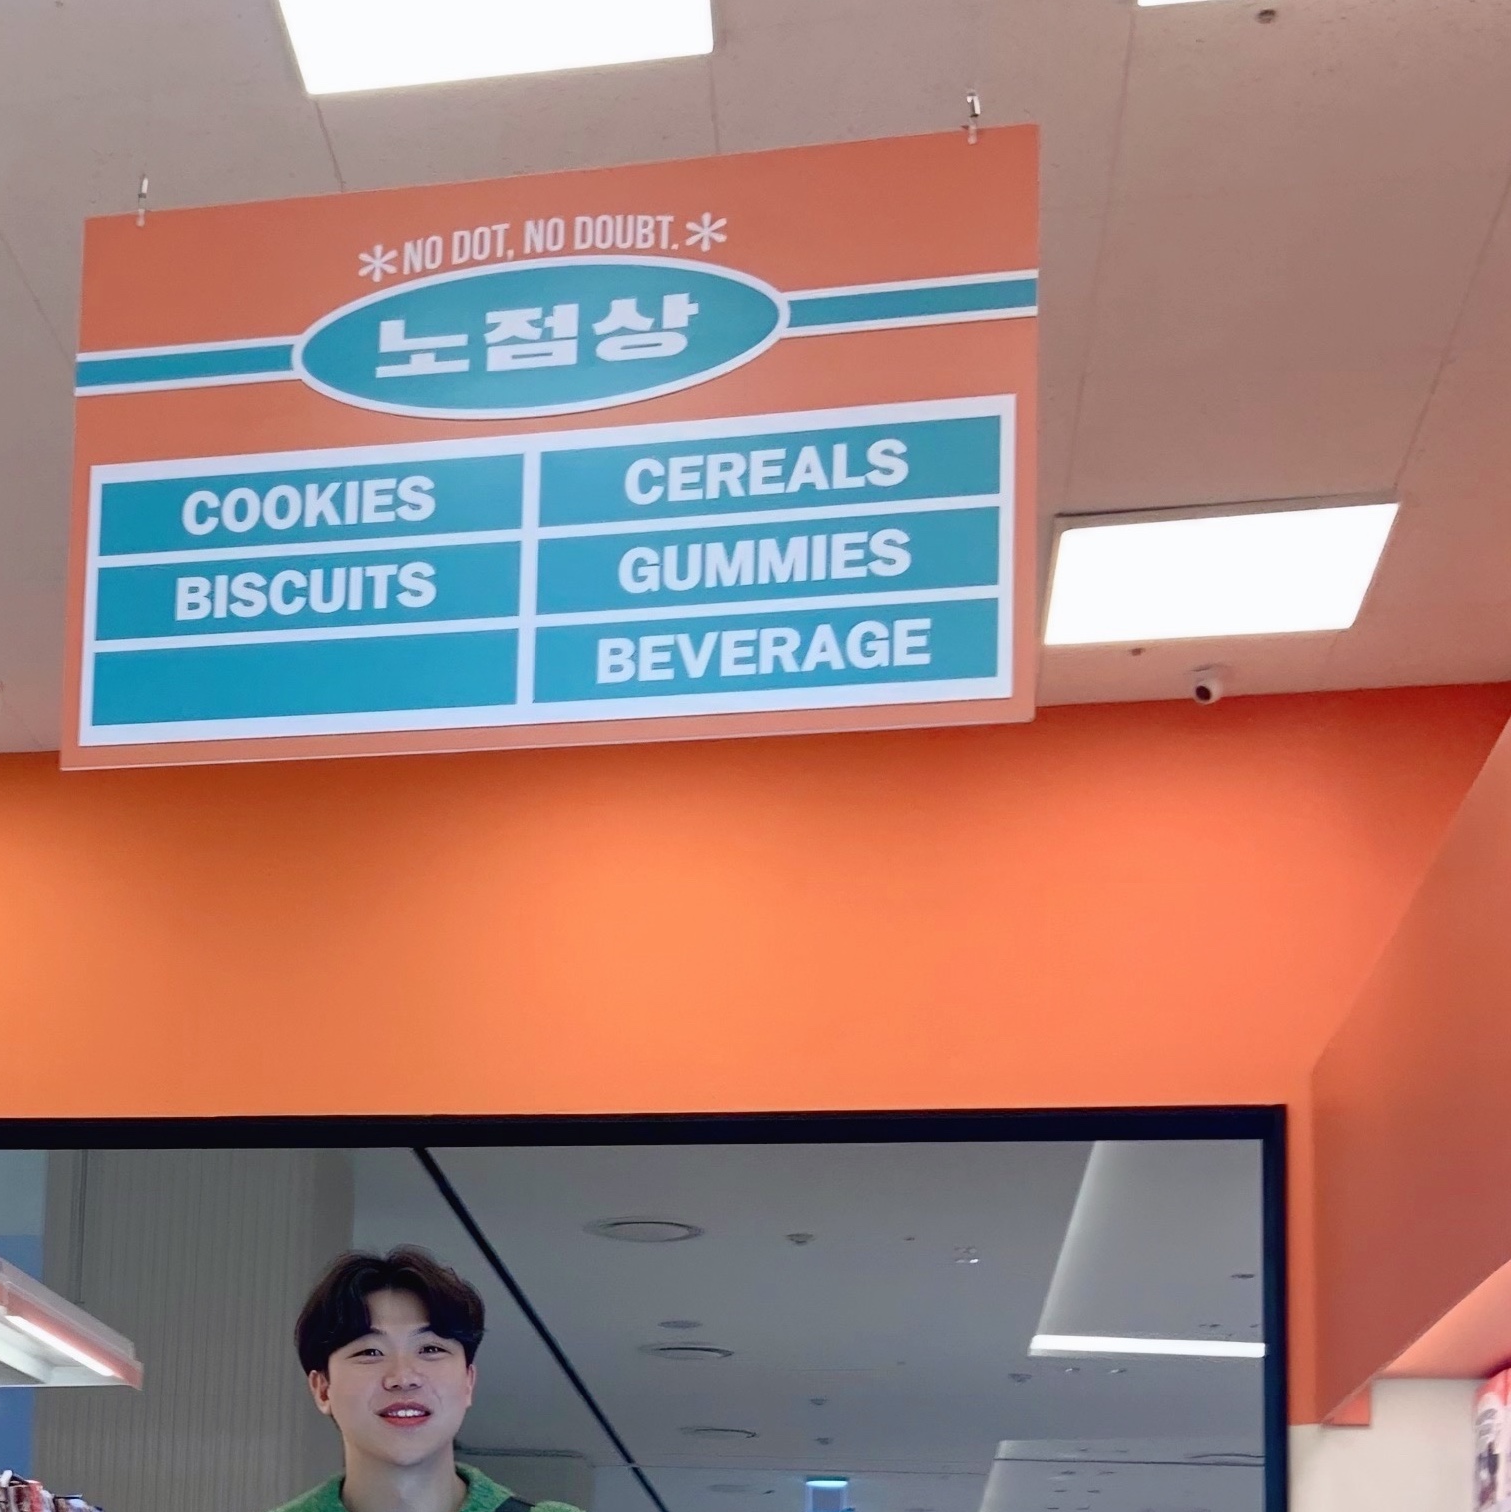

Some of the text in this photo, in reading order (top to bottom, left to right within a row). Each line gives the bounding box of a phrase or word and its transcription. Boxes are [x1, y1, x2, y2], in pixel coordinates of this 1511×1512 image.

[403, 214, 679, 275] NO DOT, NO DOUBT.
[375, 292, 699, 378] 노점상
[624, 438, 909, 506] CEREALS
[183, 475, 436, 536] COOKIES
[176, 561, 436, 621] BISCUITS
[618, 528, 911, 594] GUMMIES
[597, 618, 931, 684] BEVERAGE
